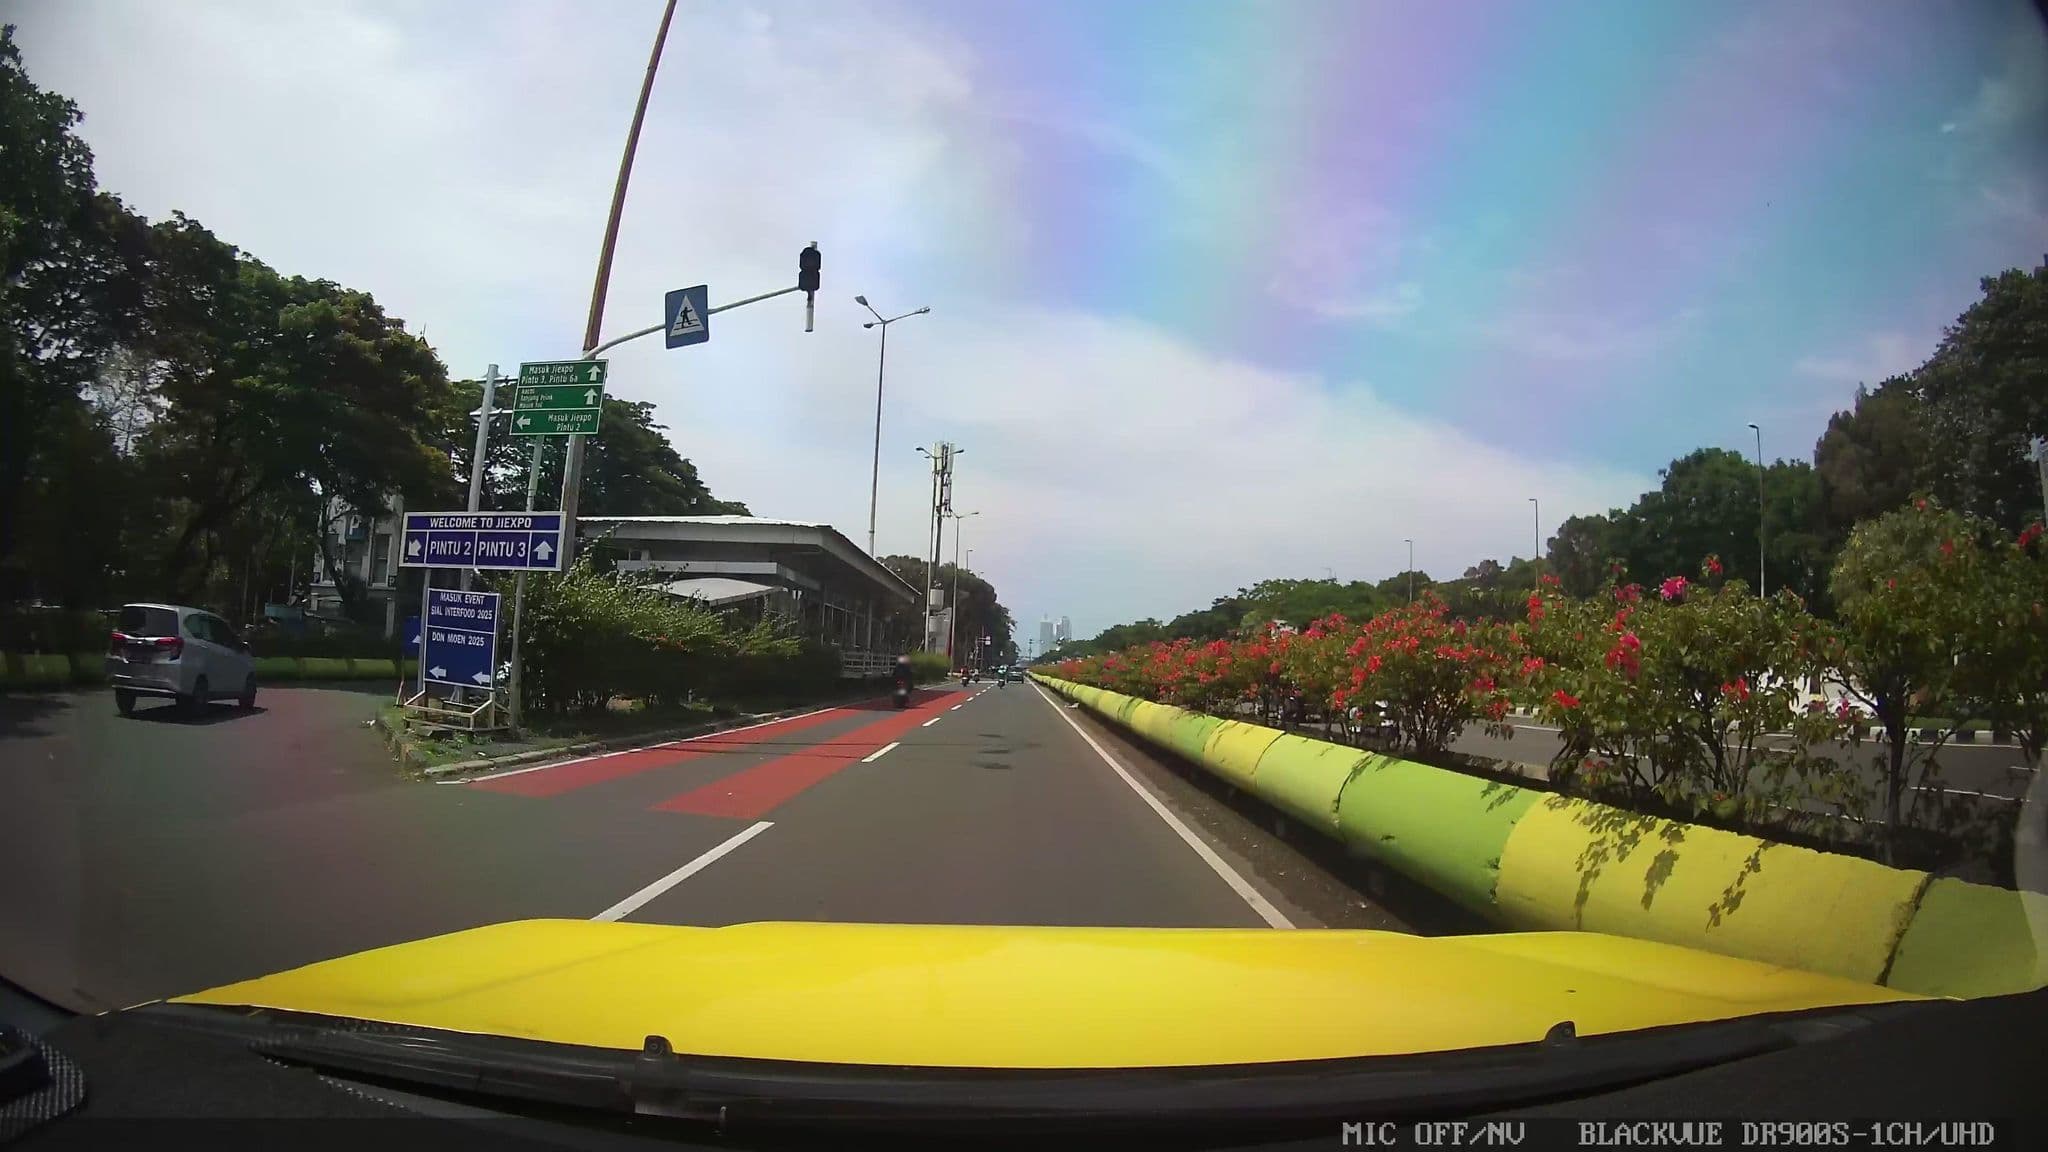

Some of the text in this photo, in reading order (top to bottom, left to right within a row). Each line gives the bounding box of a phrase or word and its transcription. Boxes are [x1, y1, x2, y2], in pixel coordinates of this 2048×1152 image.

[528, 365, 550, 375] Masuk
[549, 375, 568, 383] Pintu
[548, 413, 569, 422] Masuk
[556, 423, 581, 431] Pintu 2
[430, 517, 532, 528] WELCOME TO JIEXPO
[430, 541, 471, 555] PINTU 2
[478, 542, 526, 557] PINTU 3
[440, 592, 485, 605] MASUK EVENT
[445, 607, 476, 618] INTERFOOD
[477, 609, 493, 619] 2025
[432, 632, 485, 646] DON MOEN 2025
